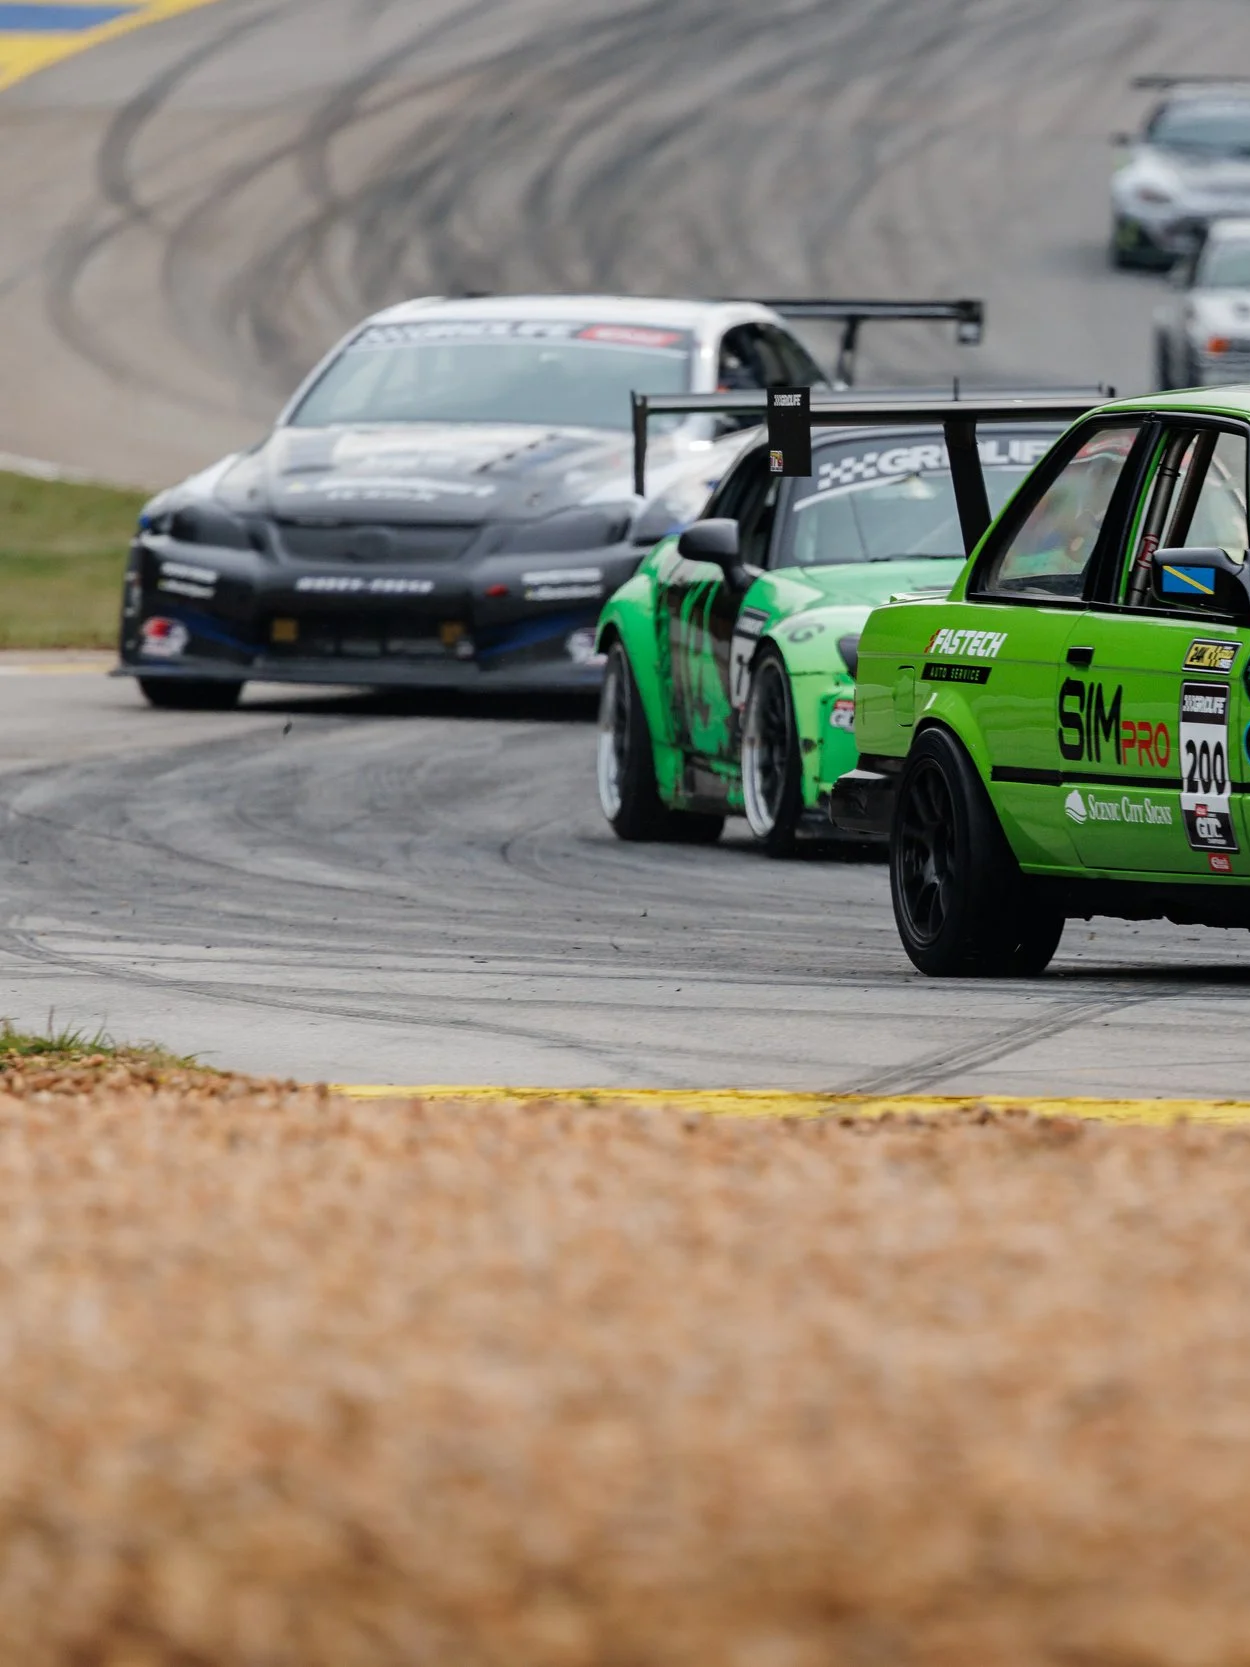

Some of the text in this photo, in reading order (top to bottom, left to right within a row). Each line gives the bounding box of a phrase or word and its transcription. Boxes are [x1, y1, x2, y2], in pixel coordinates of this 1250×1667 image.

[930, 628, 1008, 658] FASTECH
[930, 666, 981, 681] AUTO SERVICE
[1185, 739, 1226, 796] 200
